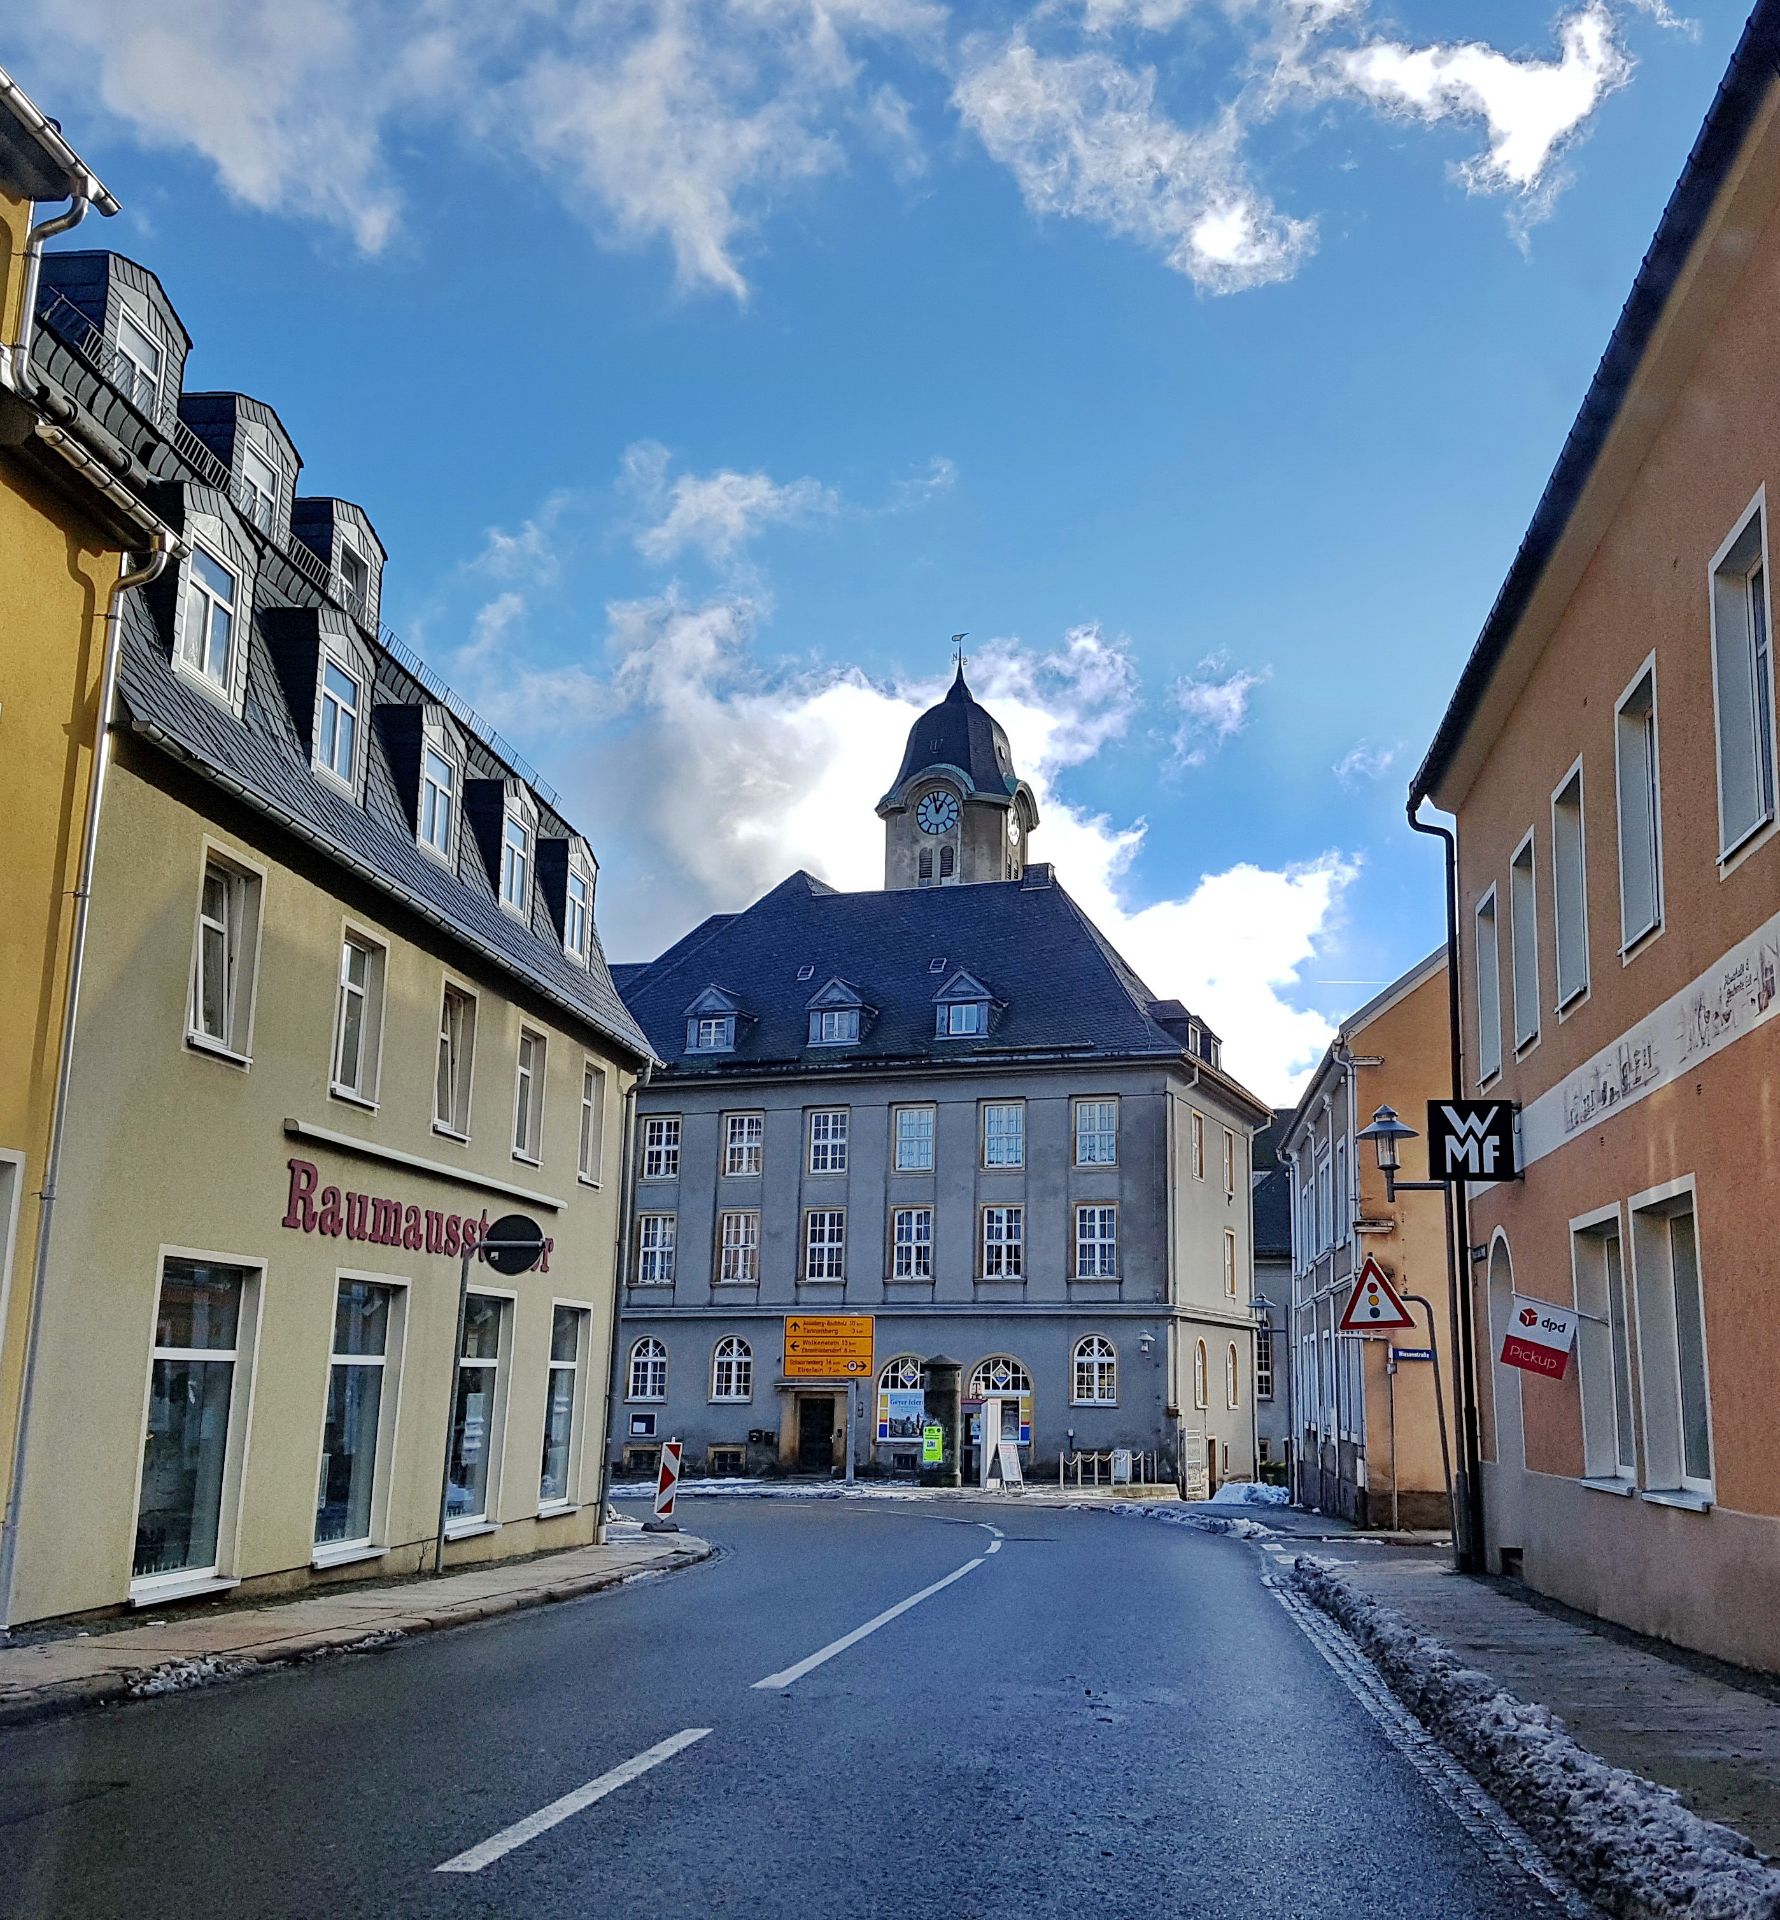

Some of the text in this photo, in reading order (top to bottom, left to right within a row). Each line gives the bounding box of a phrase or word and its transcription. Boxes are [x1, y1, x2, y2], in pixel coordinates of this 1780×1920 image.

[281, 1158, 555, 1273] Raumausstr
[1541, 1317, 1567, 1333] dpd
[1509, 1345, 1557, 1370] Pickup
